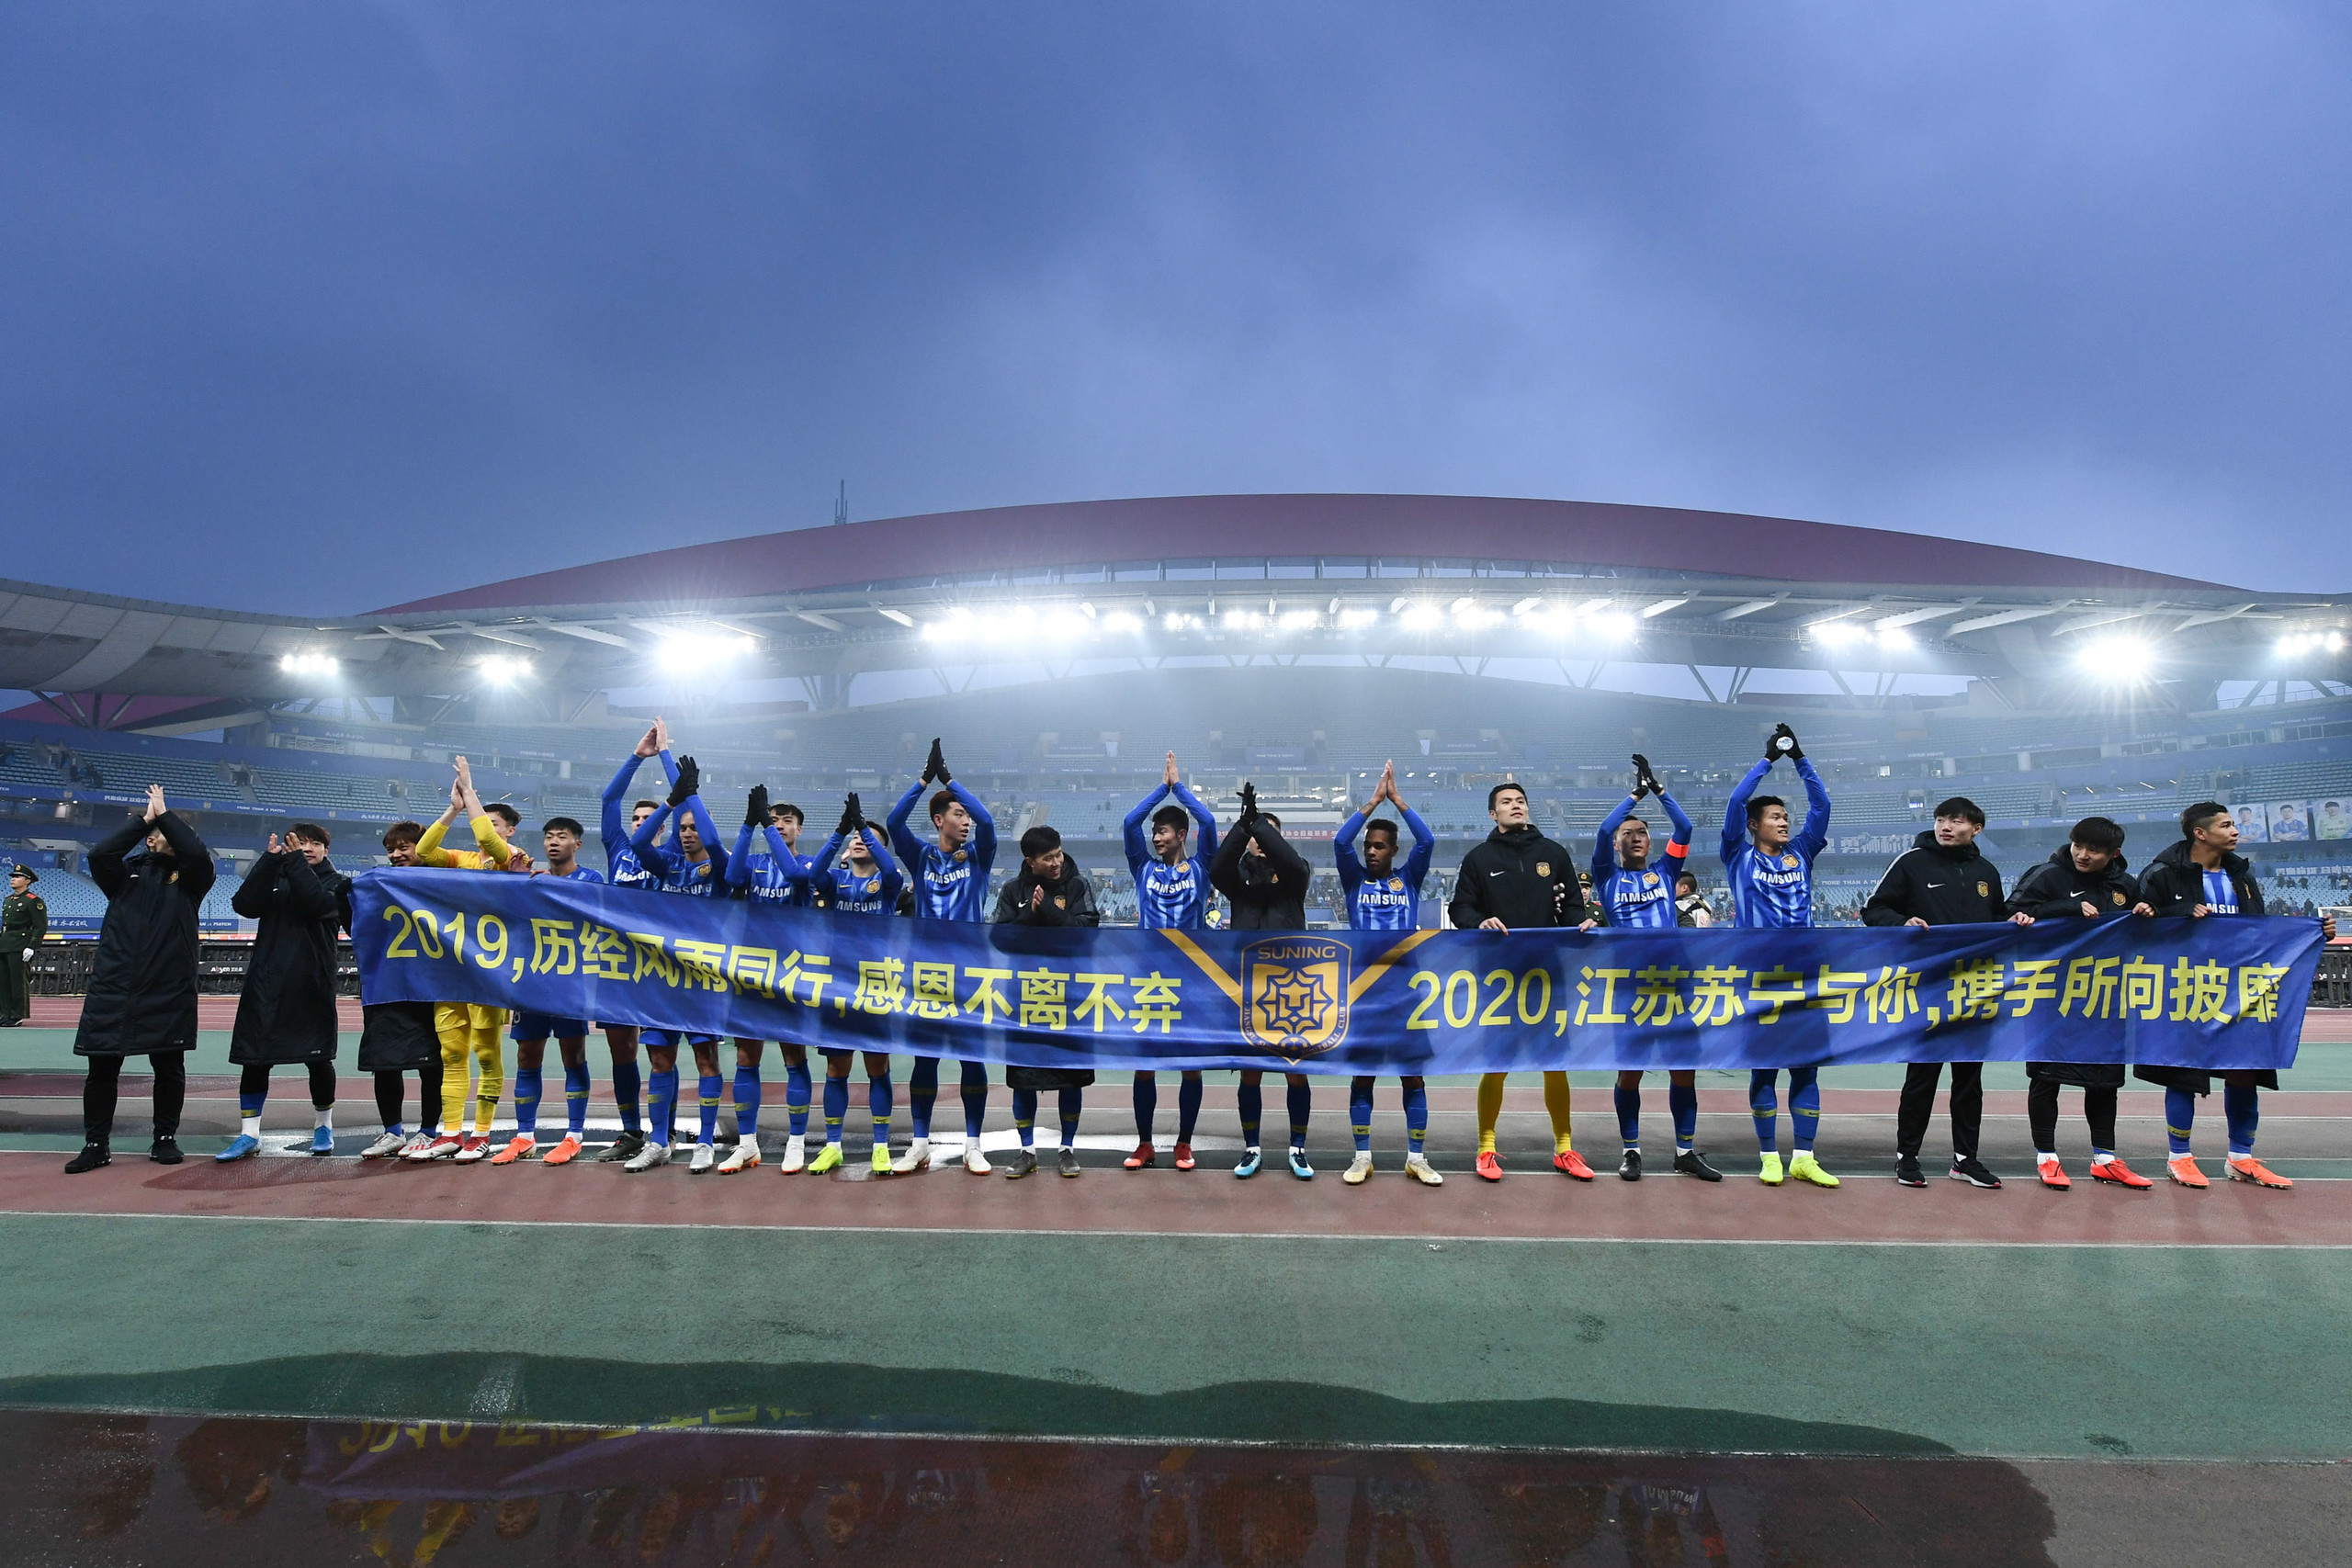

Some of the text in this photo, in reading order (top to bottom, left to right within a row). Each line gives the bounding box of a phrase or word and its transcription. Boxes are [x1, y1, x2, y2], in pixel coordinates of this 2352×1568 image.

[923, 867, 970, 884] SAMSUNG
[752, 885, 791, 898] AMSUN
[1147, 879, 1195, 894] SAMSUNG
[837, 900, 882, 912] AMSUNG
[1258, 945, 1336, 960] SUNING
[383, 905, 1182, 1033] 2019,历经风雨同行,感恩不离不弃
[1338, 1007, 1346, 1029] CLUB
